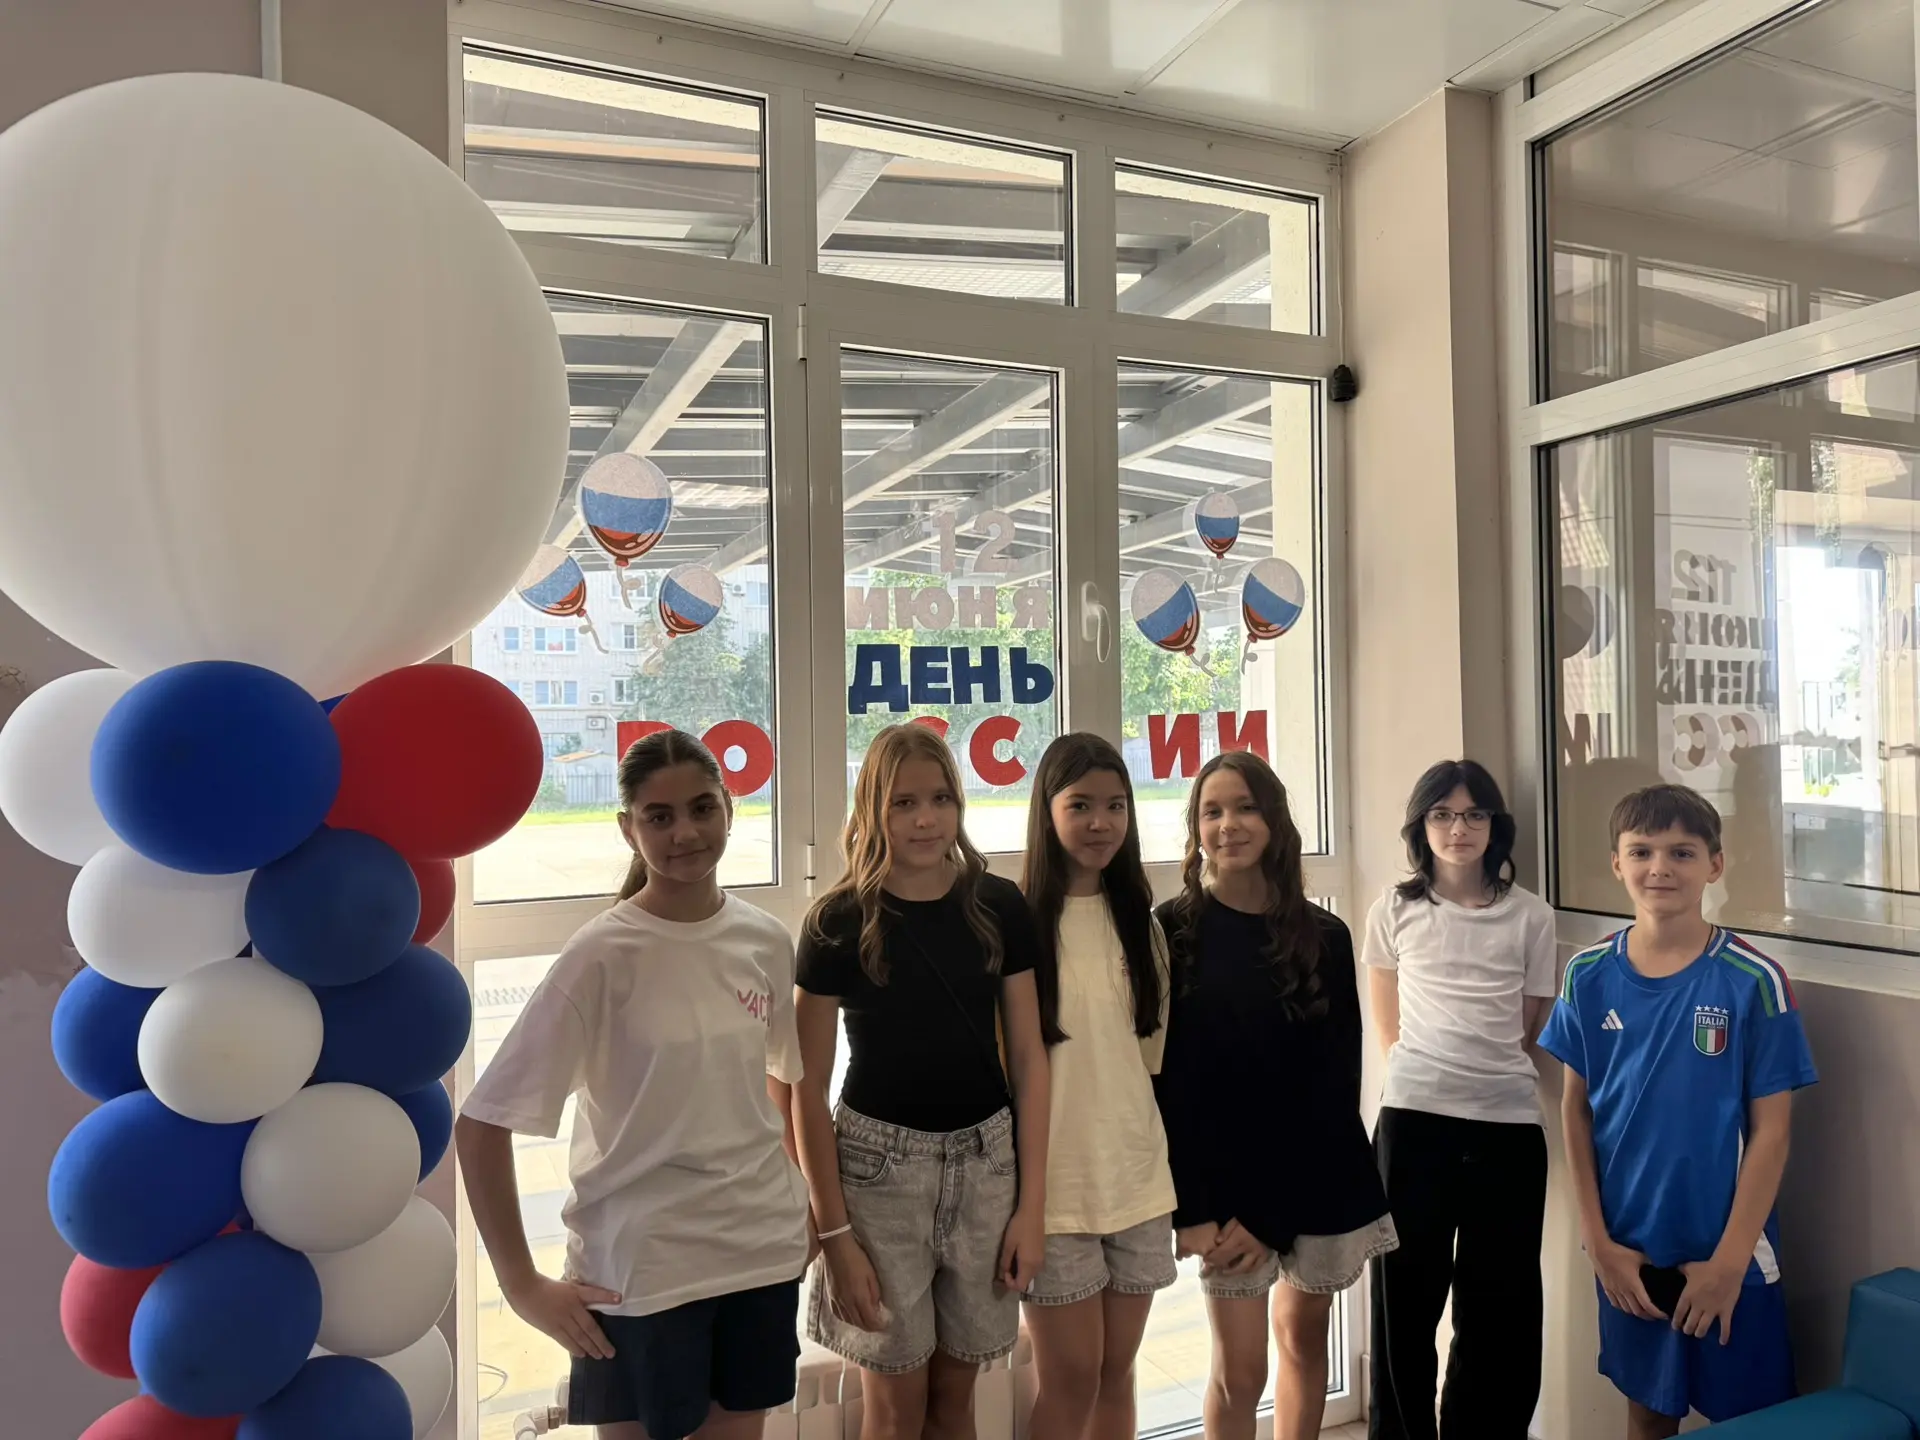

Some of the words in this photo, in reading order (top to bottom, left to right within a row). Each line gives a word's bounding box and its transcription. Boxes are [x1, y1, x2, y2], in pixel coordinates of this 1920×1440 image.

[932, 509, 1021, 573] 12
[848, 643, 1055, 715] ДЕНЬ
[1698, 1015, 1726, 1026] ITALIA
